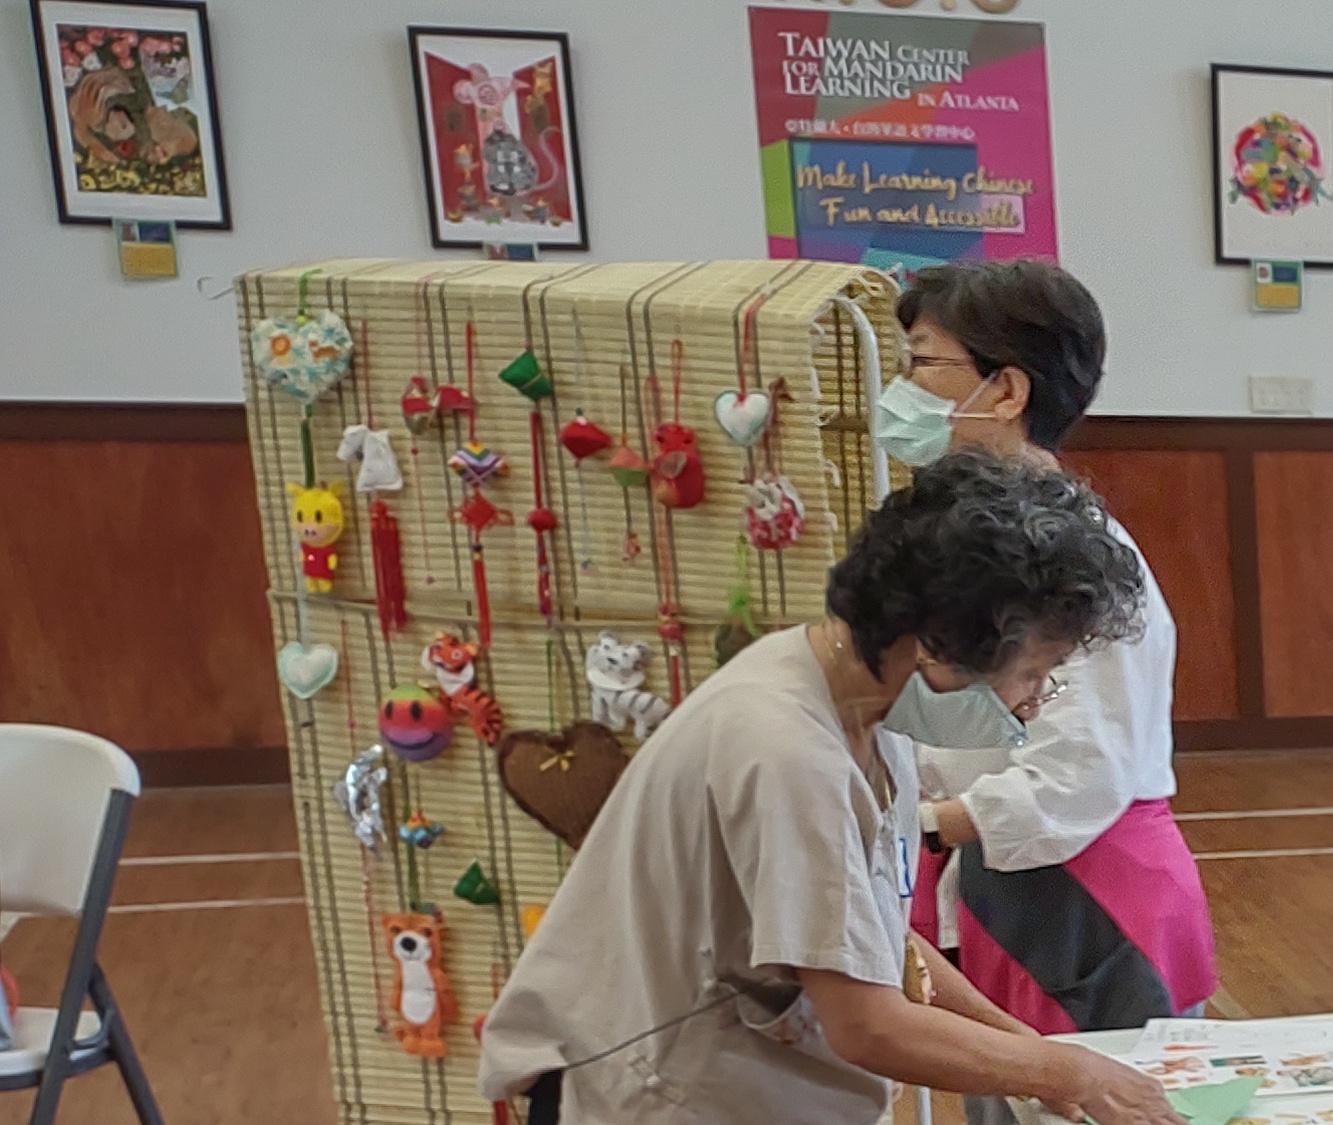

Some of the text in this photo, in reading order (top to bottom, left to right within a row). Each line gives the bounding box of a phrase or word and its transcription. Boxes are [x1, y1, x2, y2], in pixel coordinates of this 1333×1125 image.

[777, 31, 970, 65] TAIWAN CENTER
[782, 56, 963, 83] FOR MANDARIN
[784, 73, 911, 99] LEARNING
[940, 90, 1019, 111] ATLANTA
[797, 160, 1034, 201] Make Learning Chinese
[819, 196, 1021, 228] Fun and Accessible
